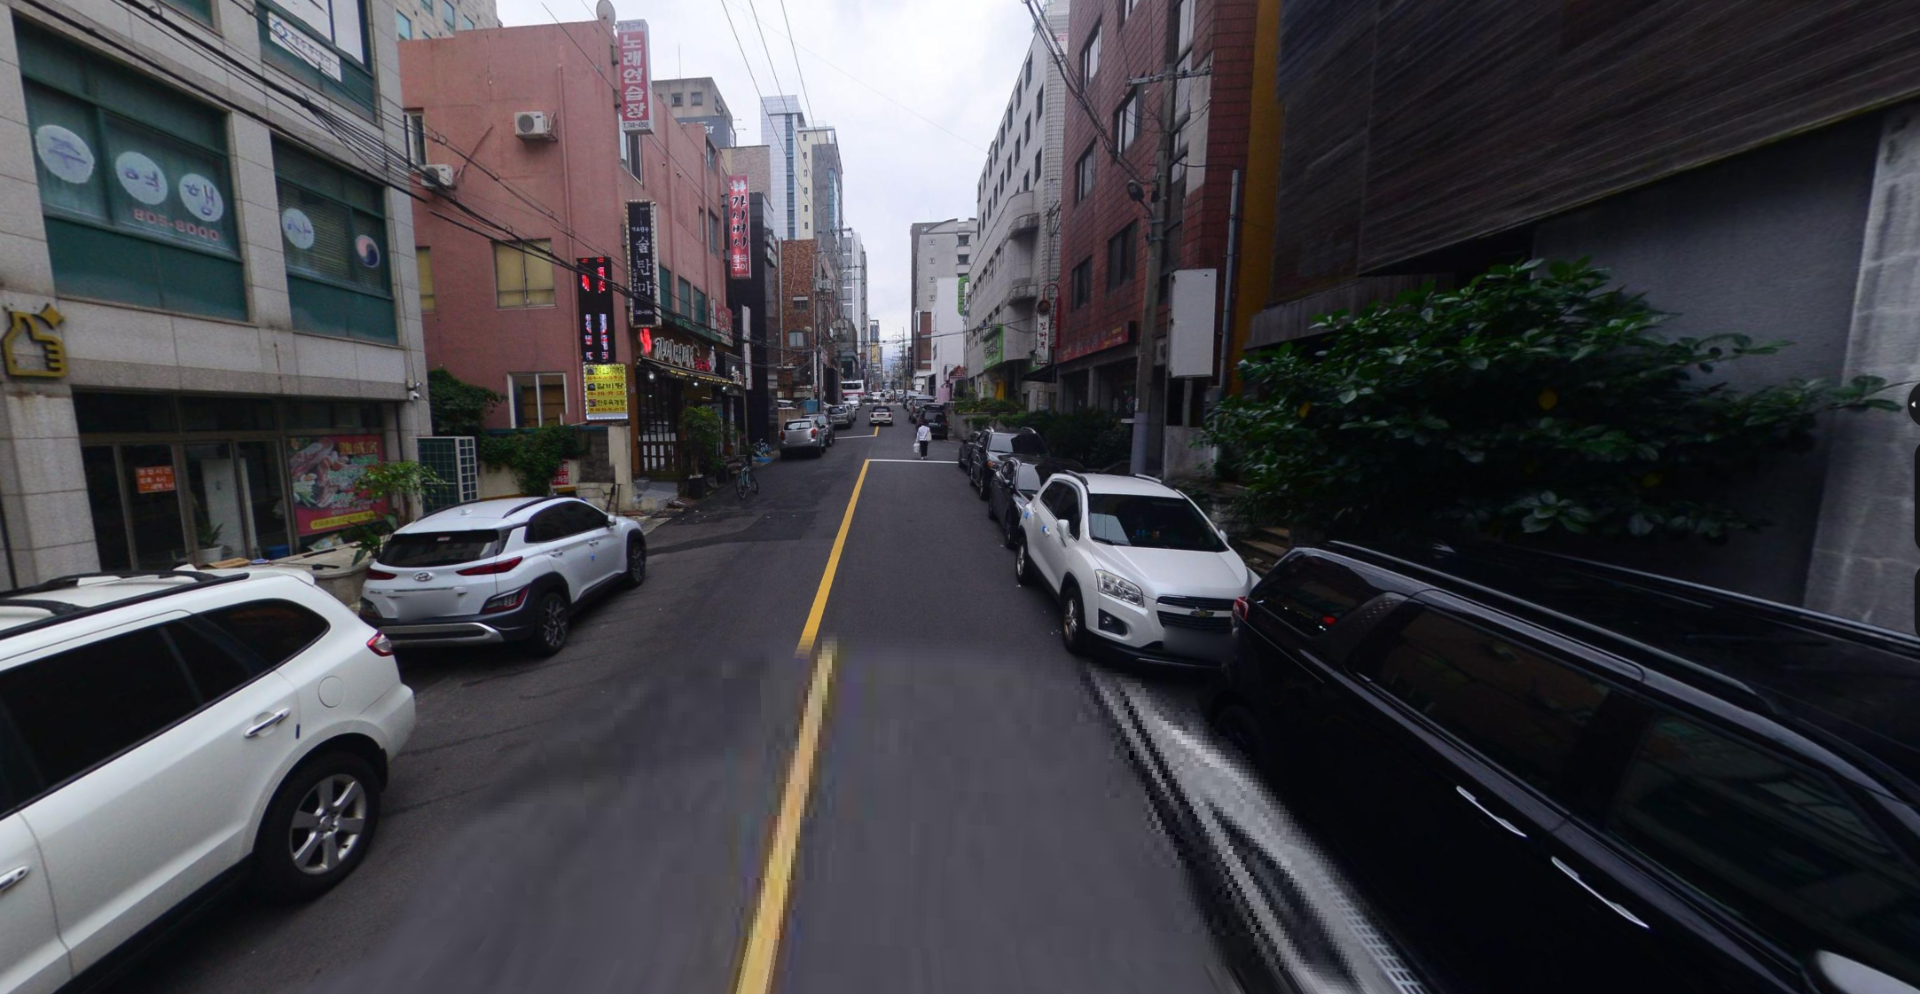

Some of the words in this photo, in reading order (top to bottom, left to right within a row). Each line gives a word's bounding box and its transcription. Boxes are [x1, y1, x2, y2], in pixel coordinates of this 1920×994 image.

[622, 34, 646, 119] 노래연습장
[731, 194, 748, 250] 가시버시
[636, 236, 652, 296] 술탄마
